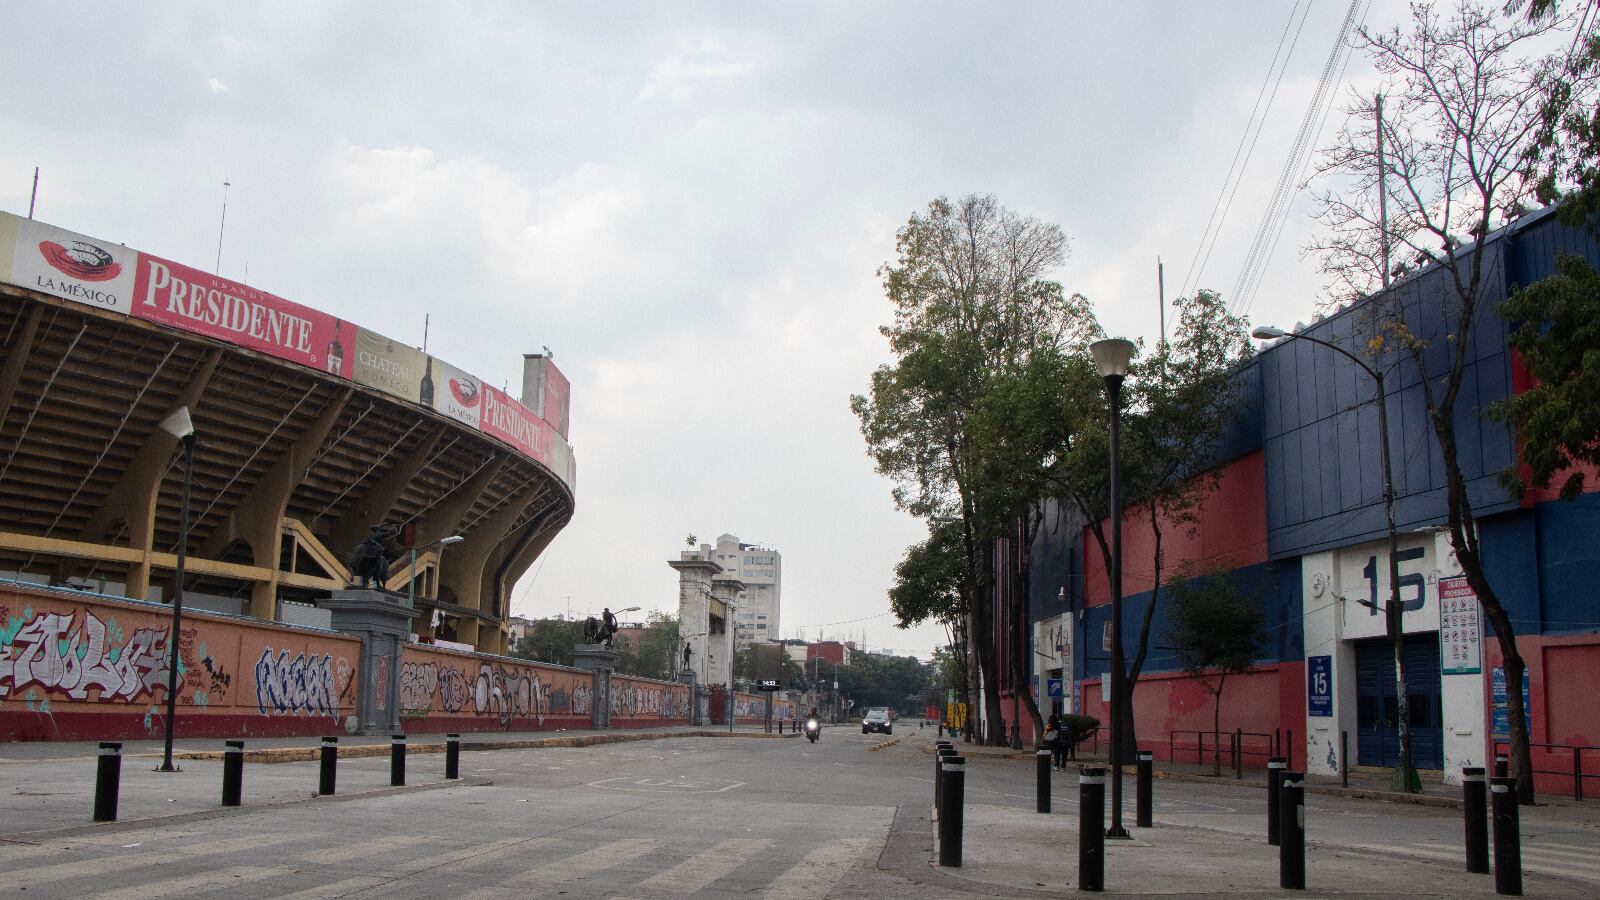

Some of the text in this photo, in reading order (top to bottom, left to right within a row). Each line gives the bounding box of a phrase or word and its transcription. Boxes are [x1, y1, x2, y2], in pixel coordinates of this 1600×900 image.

[37, 275, 117, 306] LA MÉXICO
[211, 279, 265, 302] BRANDY
[1364, 547, 1425, 616] 15
[1313, 672, 1327, 694] 15
